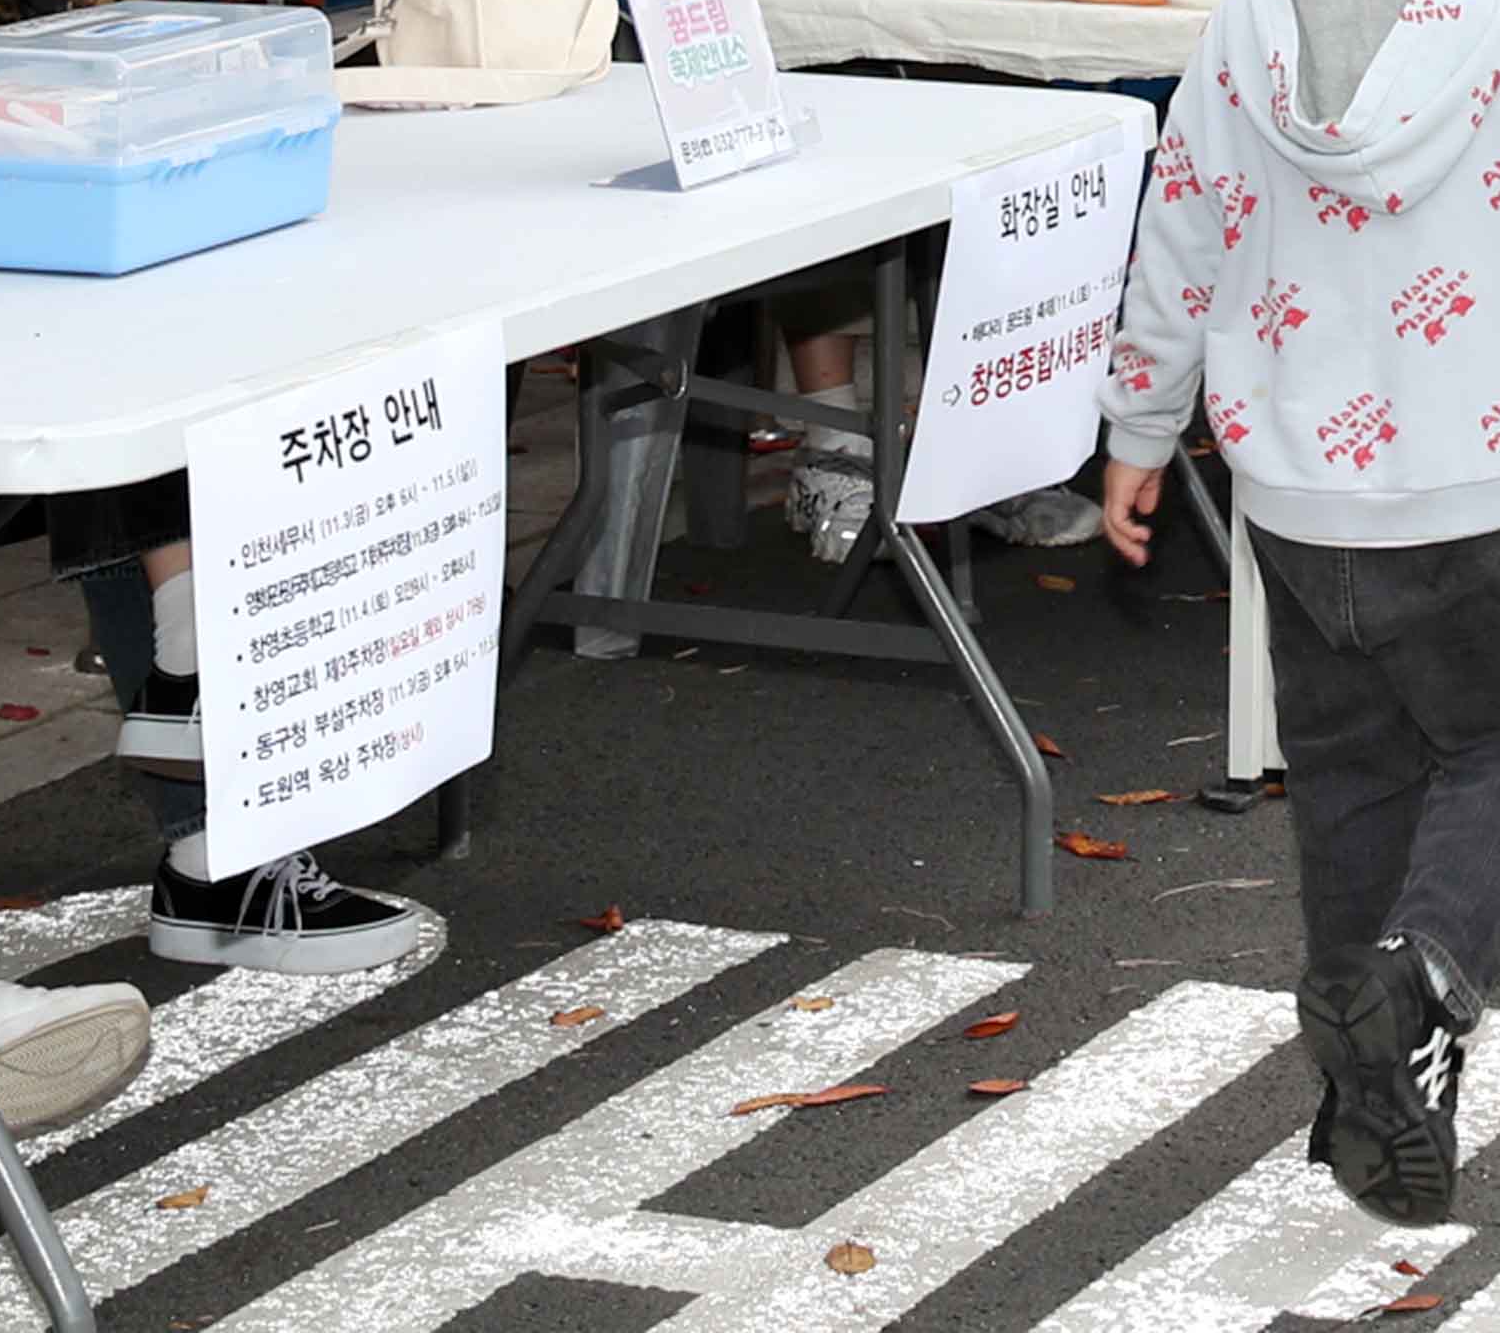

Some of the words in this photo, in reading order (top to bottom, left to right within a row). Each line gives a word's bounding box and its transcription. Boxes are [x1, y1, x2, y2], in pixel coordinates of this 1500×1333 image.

[1000, 179, 1060, 241] 화장실
[1070, 165, 1105, 219] 안내
[1391, 265, 1444, 315] Alain
[1396, 269, 1470, 339] Martine
[279, 405, 373, 485] 주차장
[383, 378, 443, 447] 안내
[1317, 392, 1374, 441] Alain
[241, 520, 315, 569] 인천세무서
[250, 610, 335, 664] 창영초등학교
[253, 666, 319, 713] 창영교회
[256, 720, 307, 761] 동구청
[314, 688, 384, 737] 부설주차장
[258, 768, 310, 807] 도원역
[319, 753, 351, 784] 옥상
